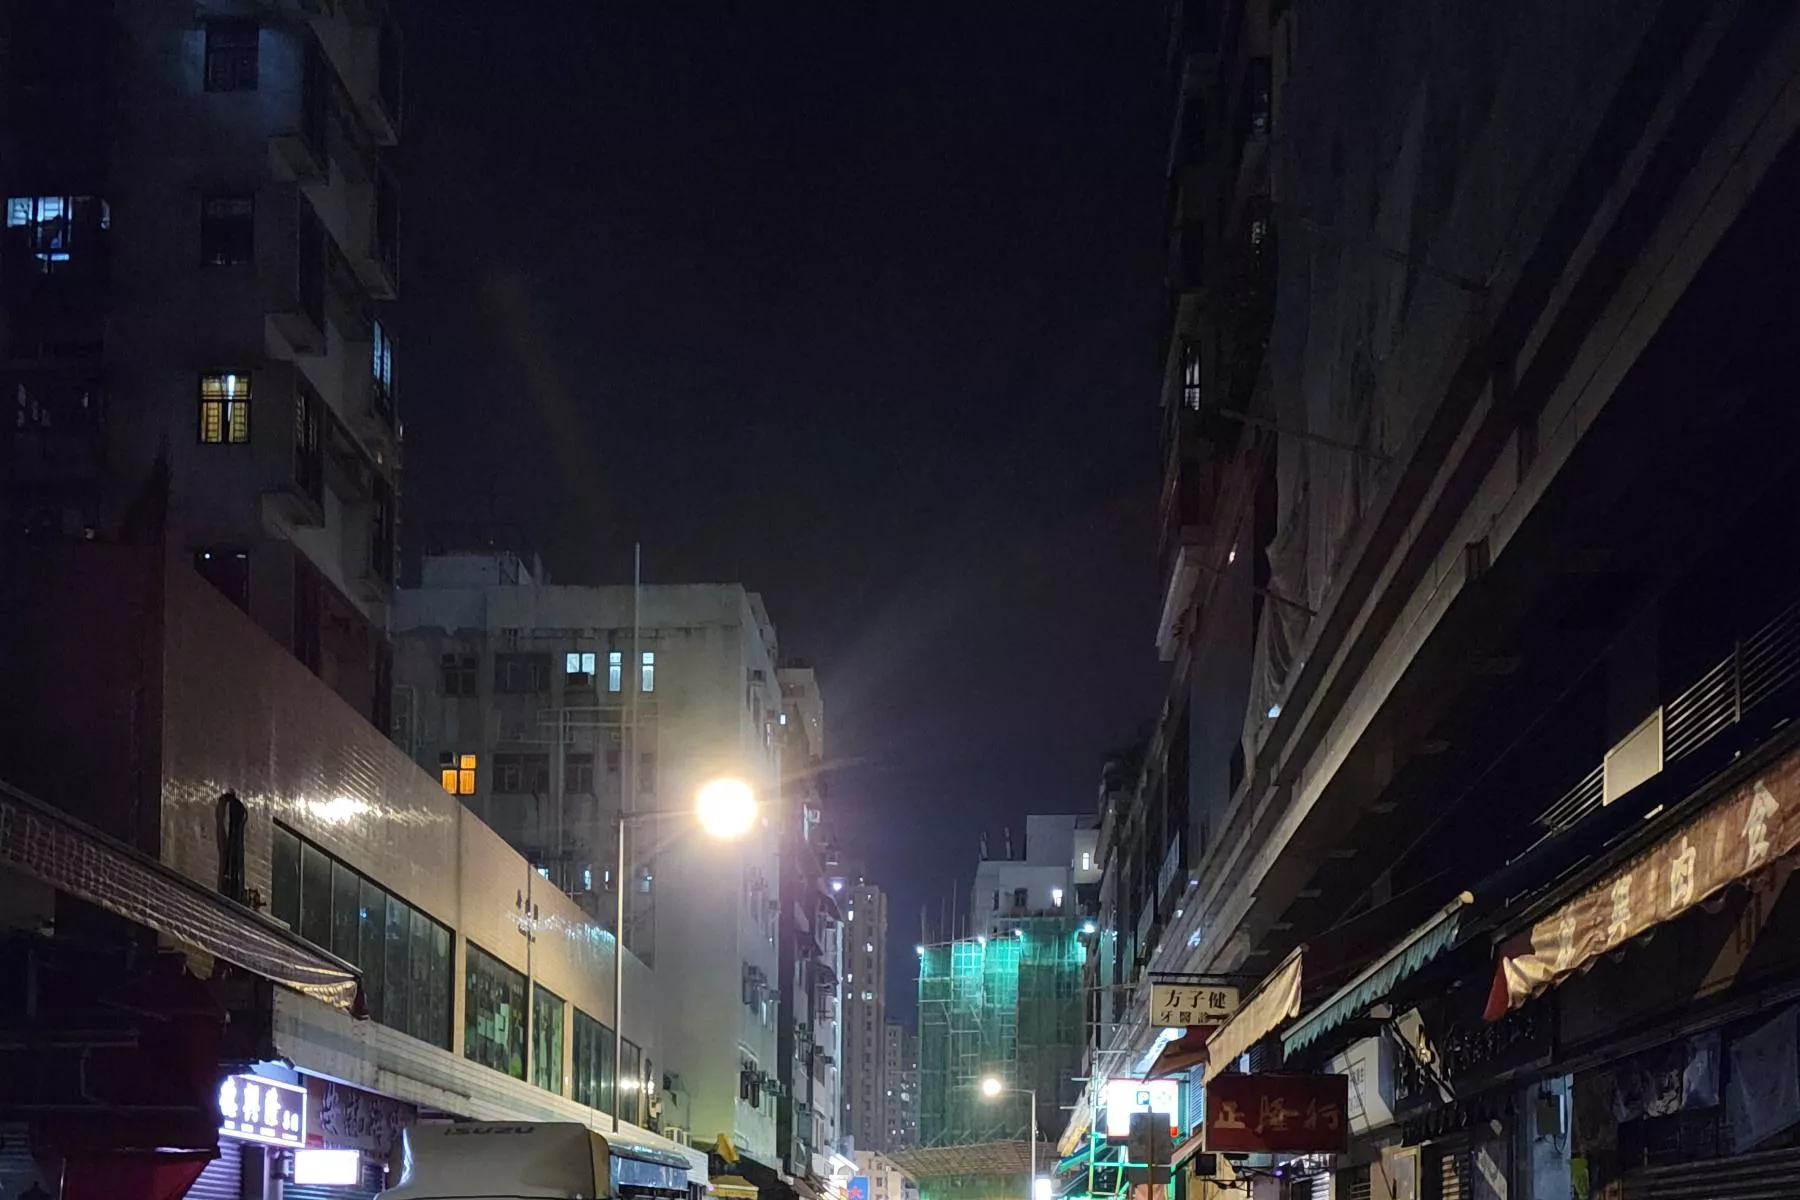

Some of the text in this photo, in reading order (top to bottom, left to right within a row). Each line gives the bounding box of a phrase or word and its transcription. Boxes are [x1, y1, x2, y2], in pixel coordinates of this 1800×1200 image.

[1164, 989, 1227, 1009] 方子健
[444, 1126, 535, 1136] ISUZU
